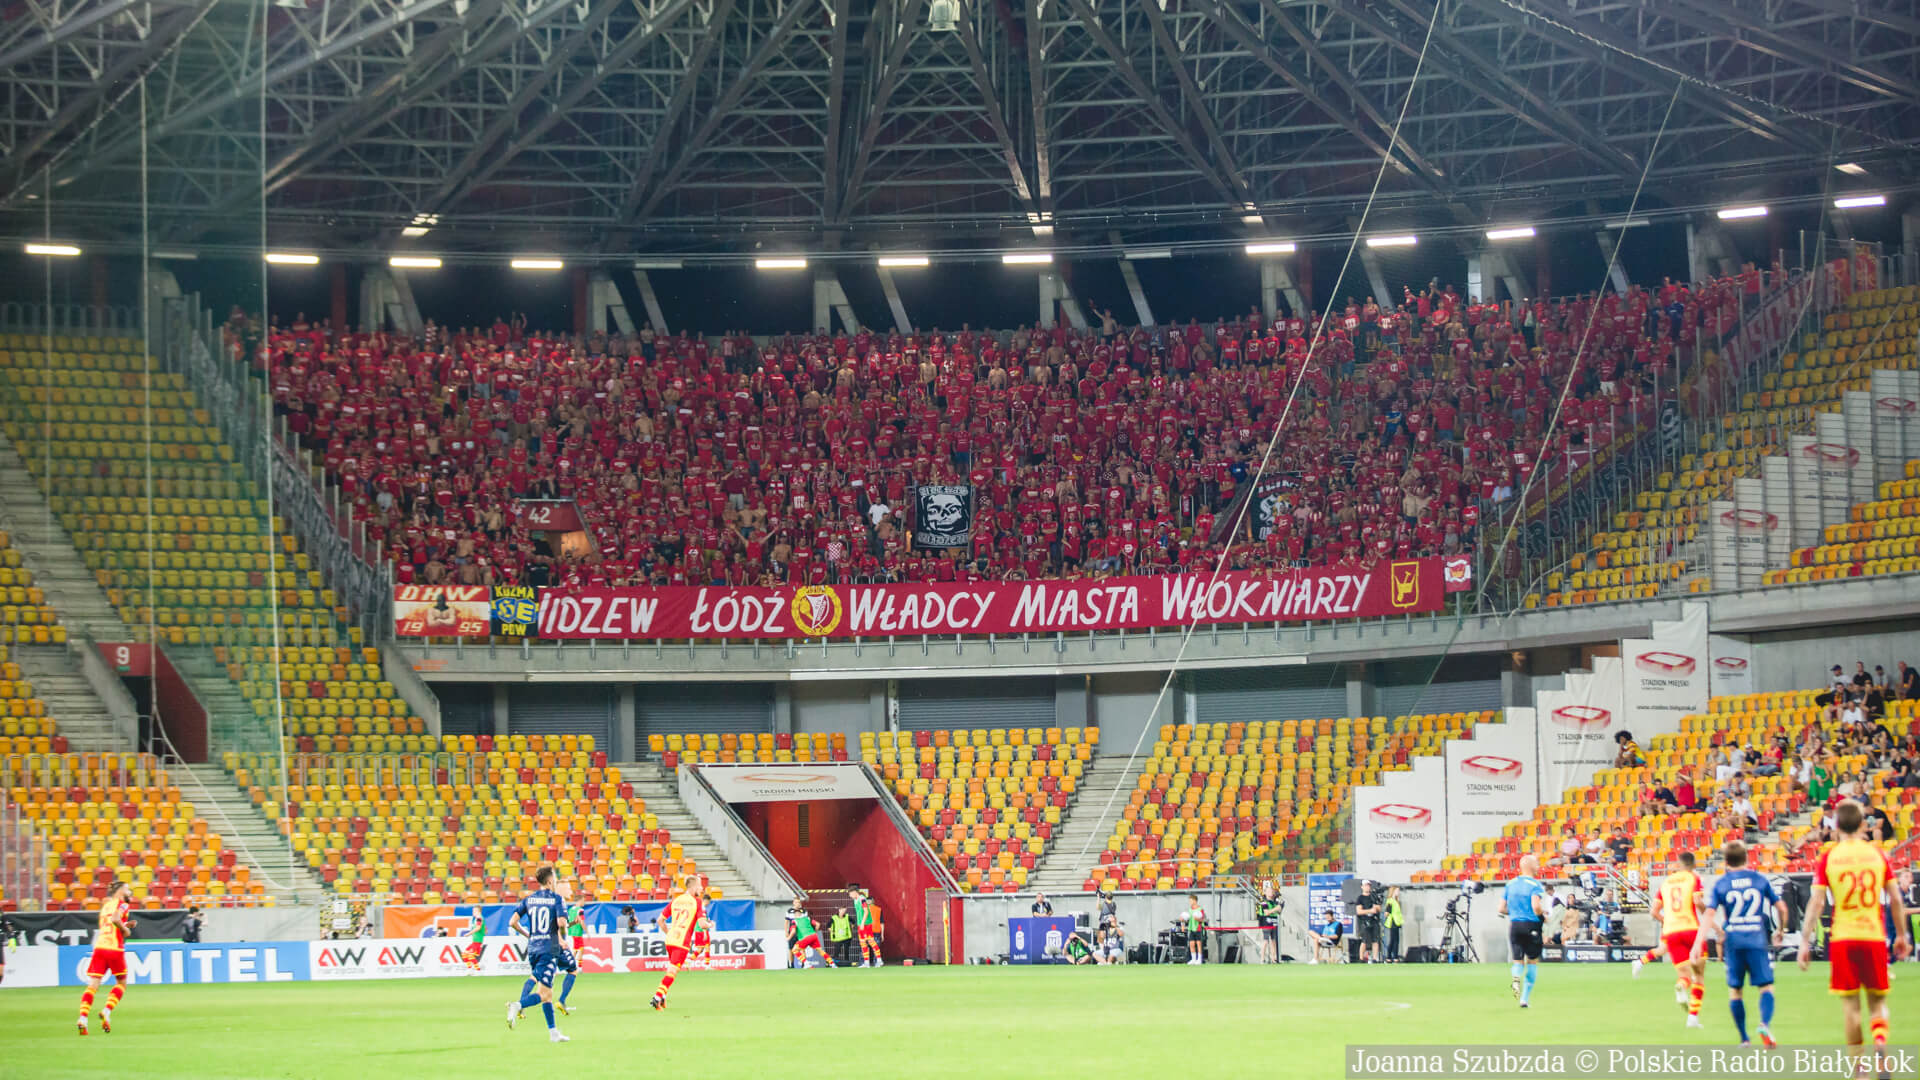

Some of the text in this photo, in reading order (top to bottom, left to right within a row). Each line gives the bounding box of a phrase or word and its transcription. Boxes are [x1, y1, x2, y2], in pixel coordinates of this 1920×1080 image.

[528, 507, 551, 523] 42
[689, 588, 785, 633] ŁÓDŹ
[850, 588, 995, 631] WŁADCY
[1010, 584, 1138, 627] MIASTA
[403, 621, 483, 633] 19 95
[116, 646, 130, 664] 9
[1839, 869, 1876, 910] 28
[1726, 888, 1762, 923] 22
[528, 906, 550, 934] 10
[674, 908, 689, 928] 72
[621, 936, 764, 957] Biamex
